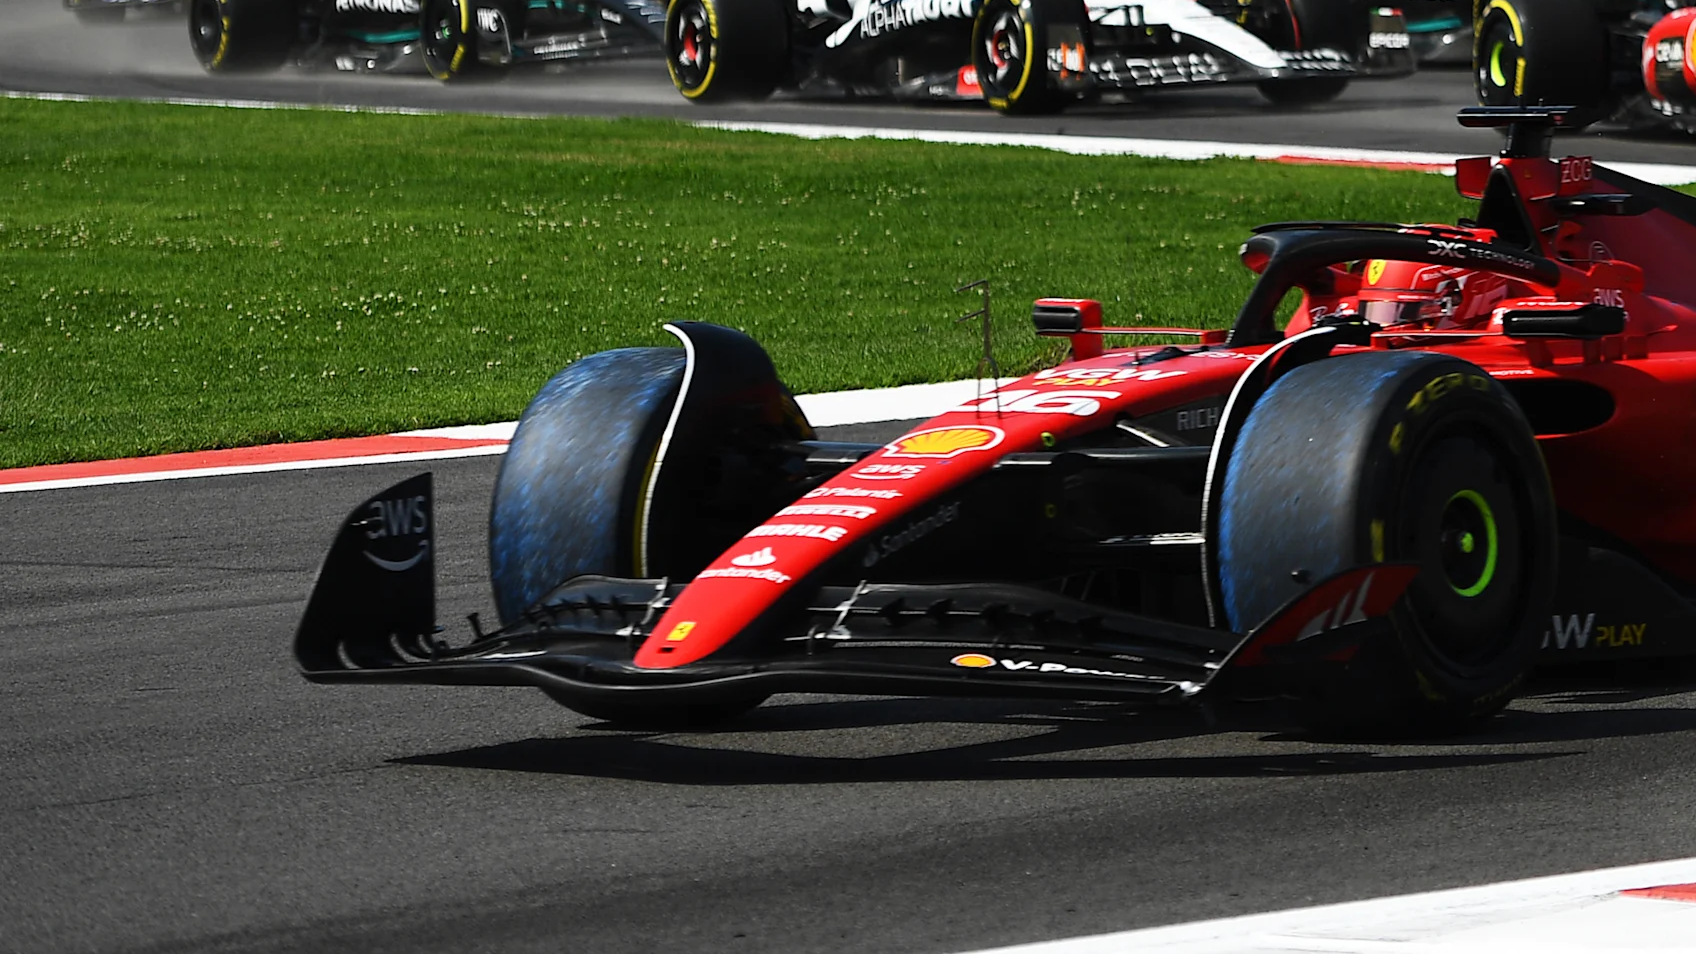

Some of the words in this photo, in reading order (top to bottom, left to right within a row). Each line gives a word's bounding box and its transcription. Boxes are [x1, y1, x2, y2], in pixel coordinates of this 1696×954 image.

[1469, 247, 1536, 270] TECHNOLOGY
[1030, 377, 1125, 387] PLAY
[1032, 367, 1188, 382] VGW
[953, 388, 1123, 417] 16
[857, 463, 927, 475] aws
[364, 494, 428, 540] aws
[742, 523, 848, 542] MAHLE
[880, 500, 961, 559] Santander
[1596, 622, 1648, 648] PLAY
